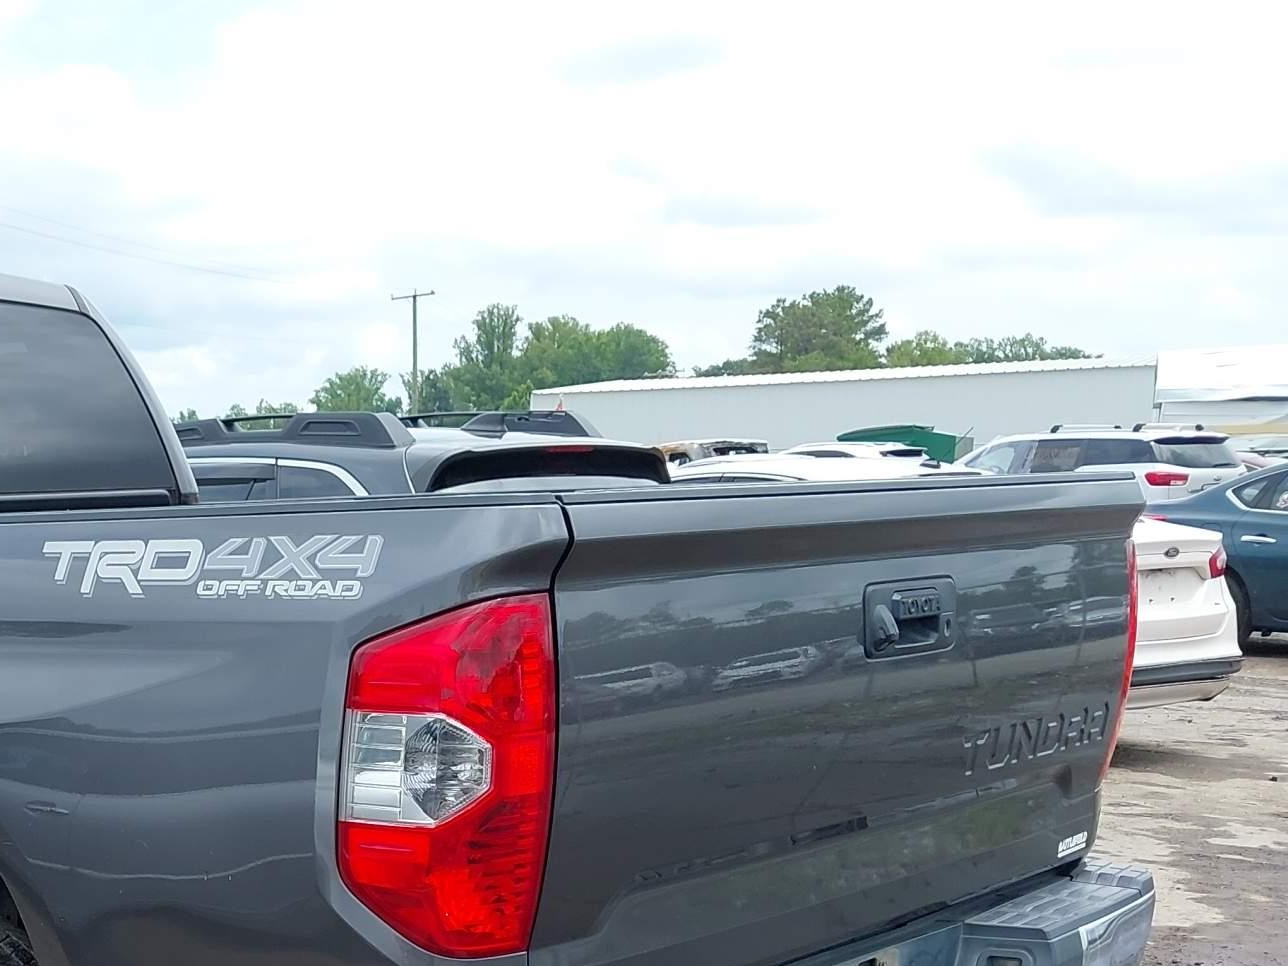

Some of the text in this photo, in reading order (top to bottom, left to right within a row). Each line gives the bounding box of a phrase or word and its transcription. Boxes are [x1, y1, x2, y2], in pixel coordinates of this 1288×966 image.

[42, 535, 385, 598] TRD 4X4
[196, 579, 364, 599] OFF ROAD
[963, 701, 1110, 776] TUNDRA
